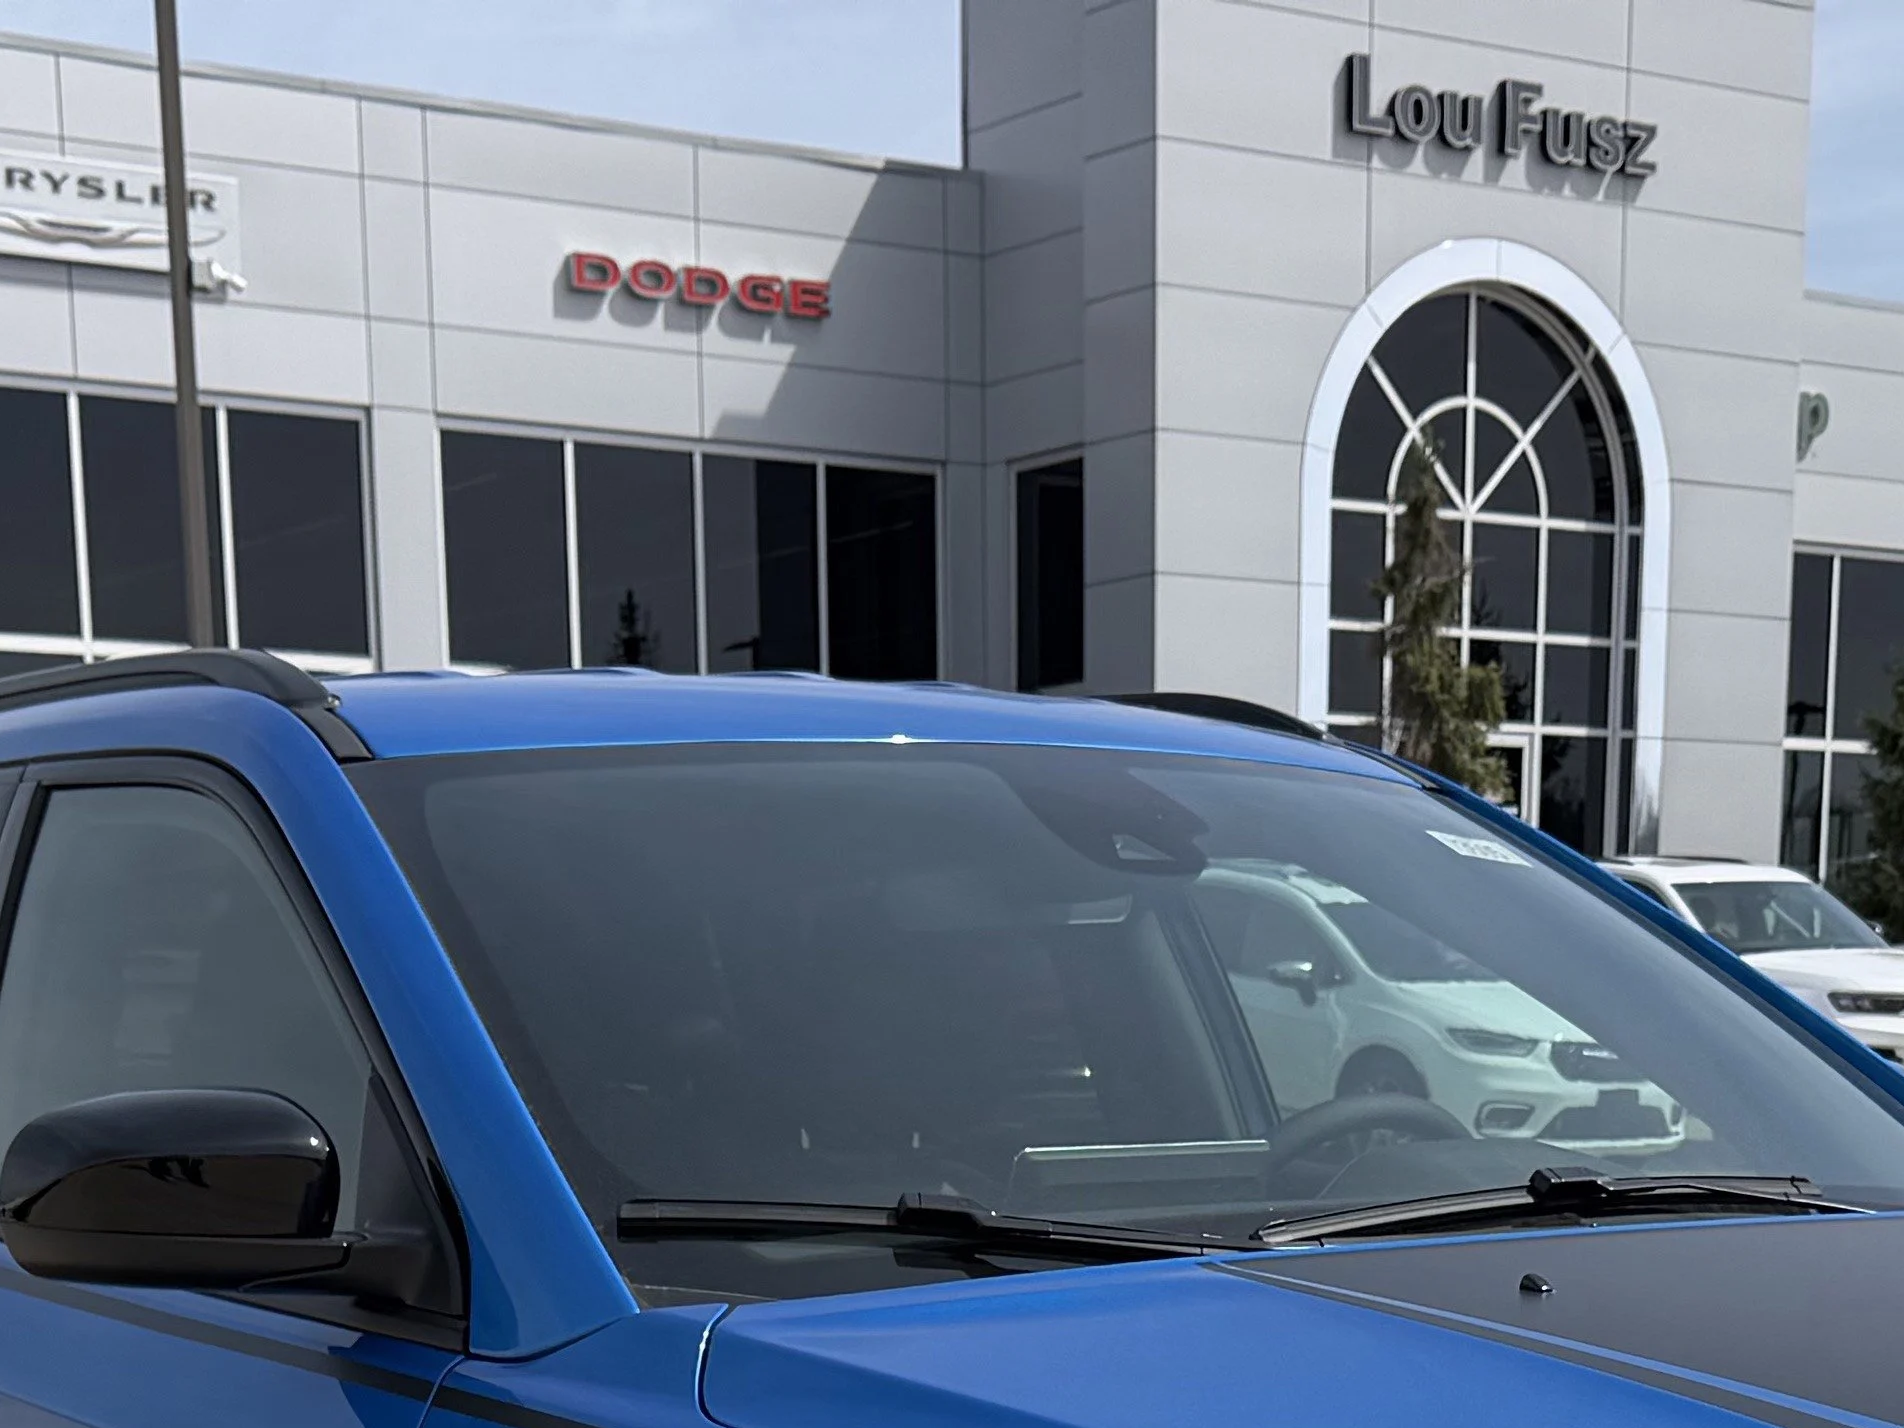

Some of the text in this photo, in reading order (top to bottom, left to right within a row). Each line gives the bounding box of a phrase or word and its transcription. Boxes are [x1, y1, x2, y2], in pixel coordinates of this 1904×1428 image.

[1344, 52, 1658, 178] Lou Fusz
[568, 252, 831, 319] DODGE
